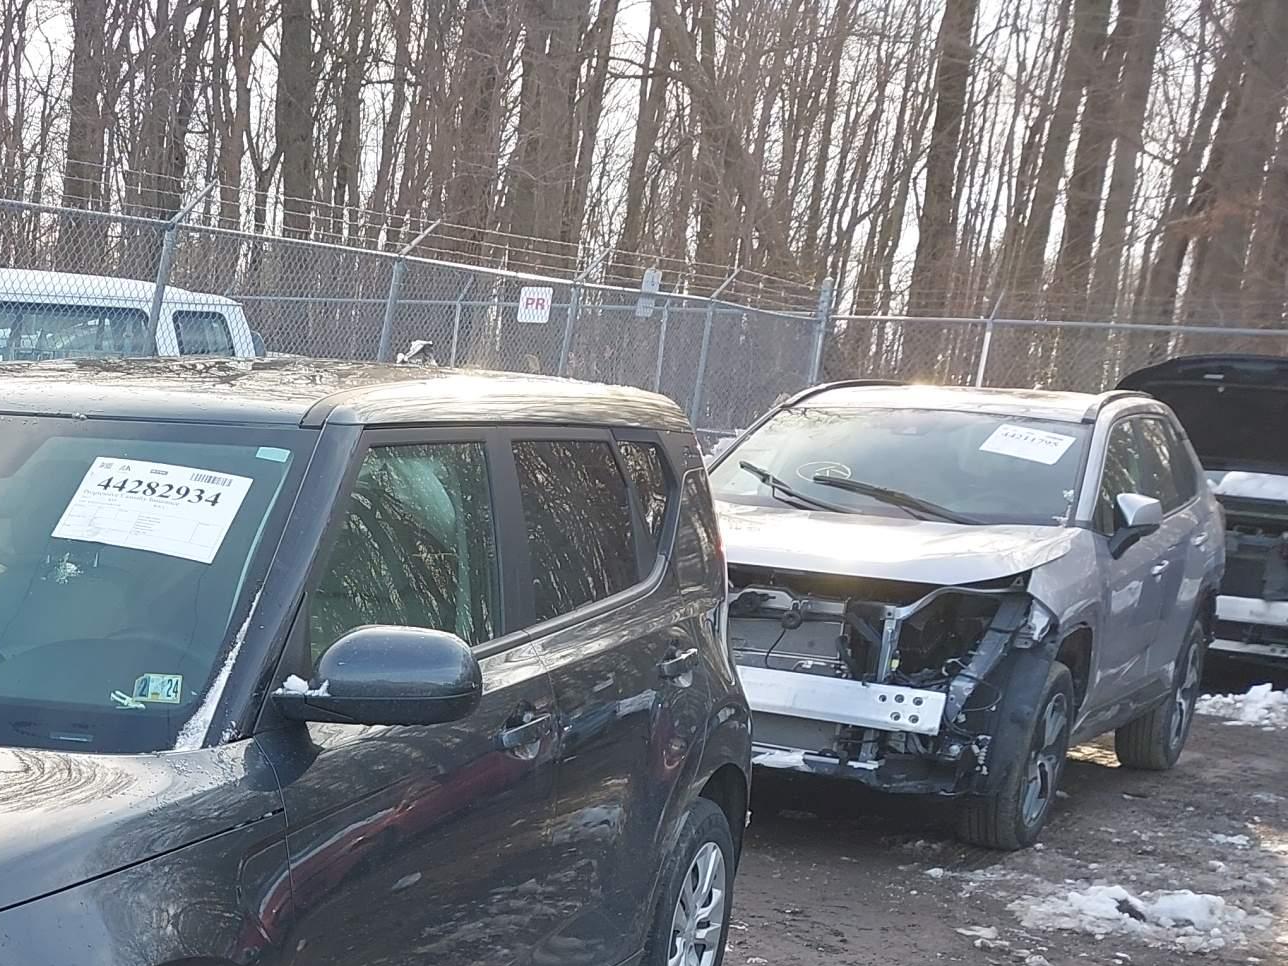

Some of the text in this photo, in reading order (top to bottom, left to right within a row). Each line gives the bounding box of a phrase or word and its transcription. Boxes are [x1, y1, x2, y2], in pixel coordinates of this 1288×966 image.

[525, 297, 546, 310] PR
[97, 476, 222, 507] 44282934
[166, 678, 179, 698] 24
